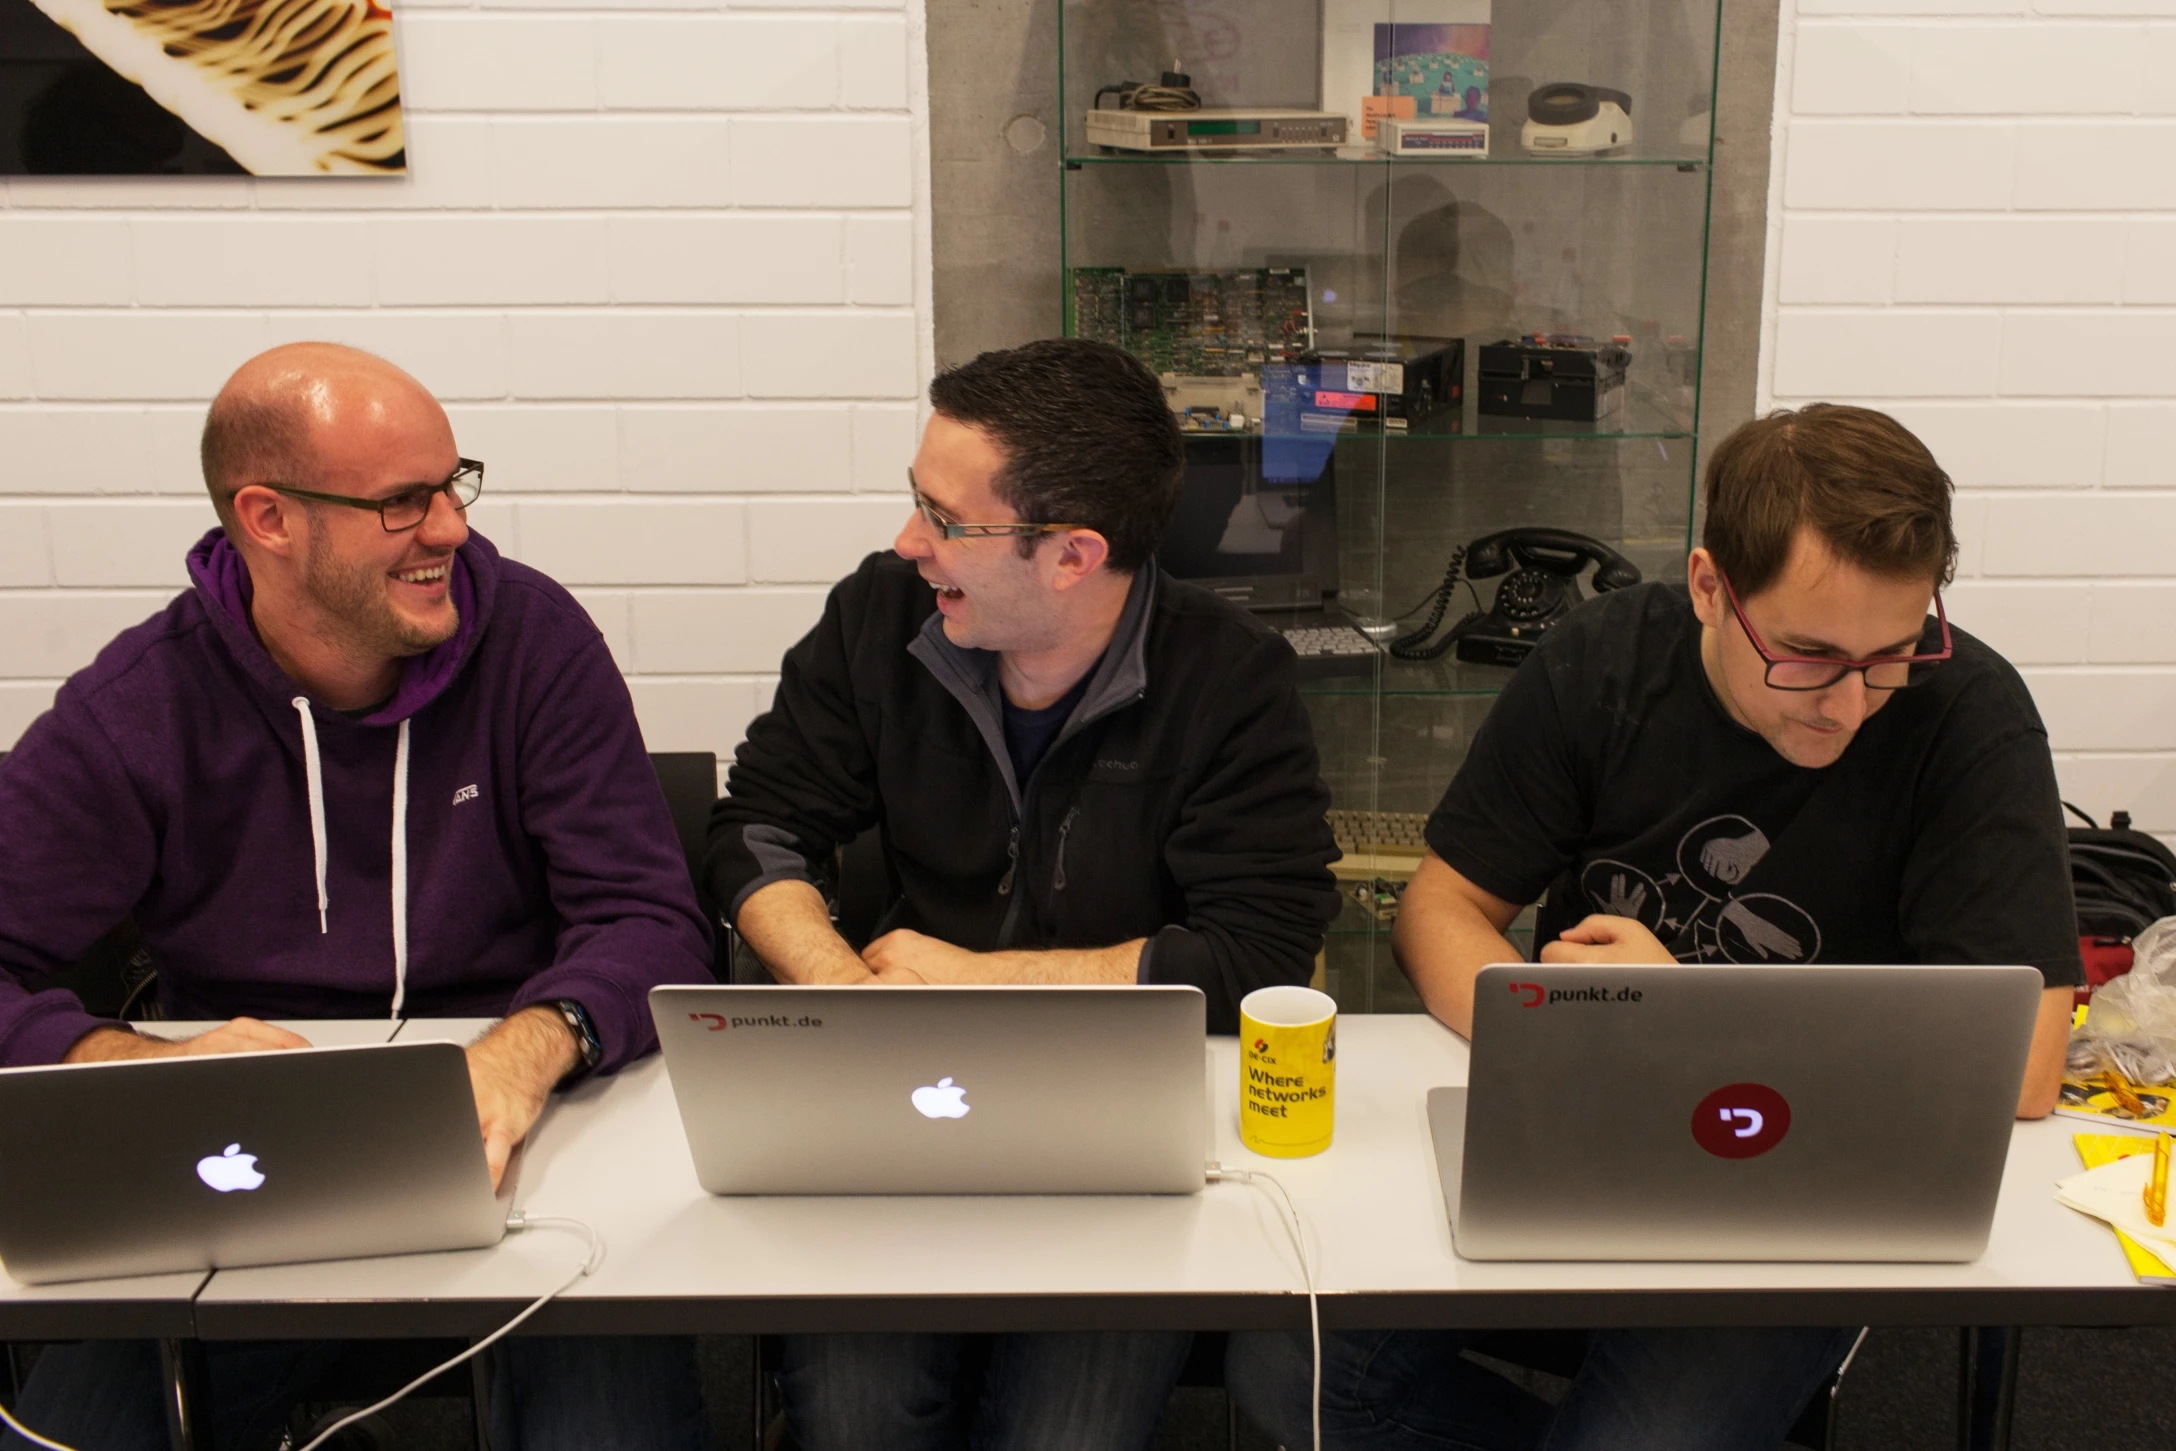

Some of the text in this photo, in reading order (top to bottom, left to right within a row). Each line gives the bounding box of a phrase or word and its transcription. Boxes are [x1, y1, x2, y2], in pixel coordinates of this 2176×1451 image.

[1549, 986, 1643, 1005] punkt.de
[731, 1014, 823, 1029] punkt.de
[1248, 1065, 1304, 1088] Where
[1249, 1084, 1327, 1103] networks
[1249, 1100, 1288, 1118] meet
